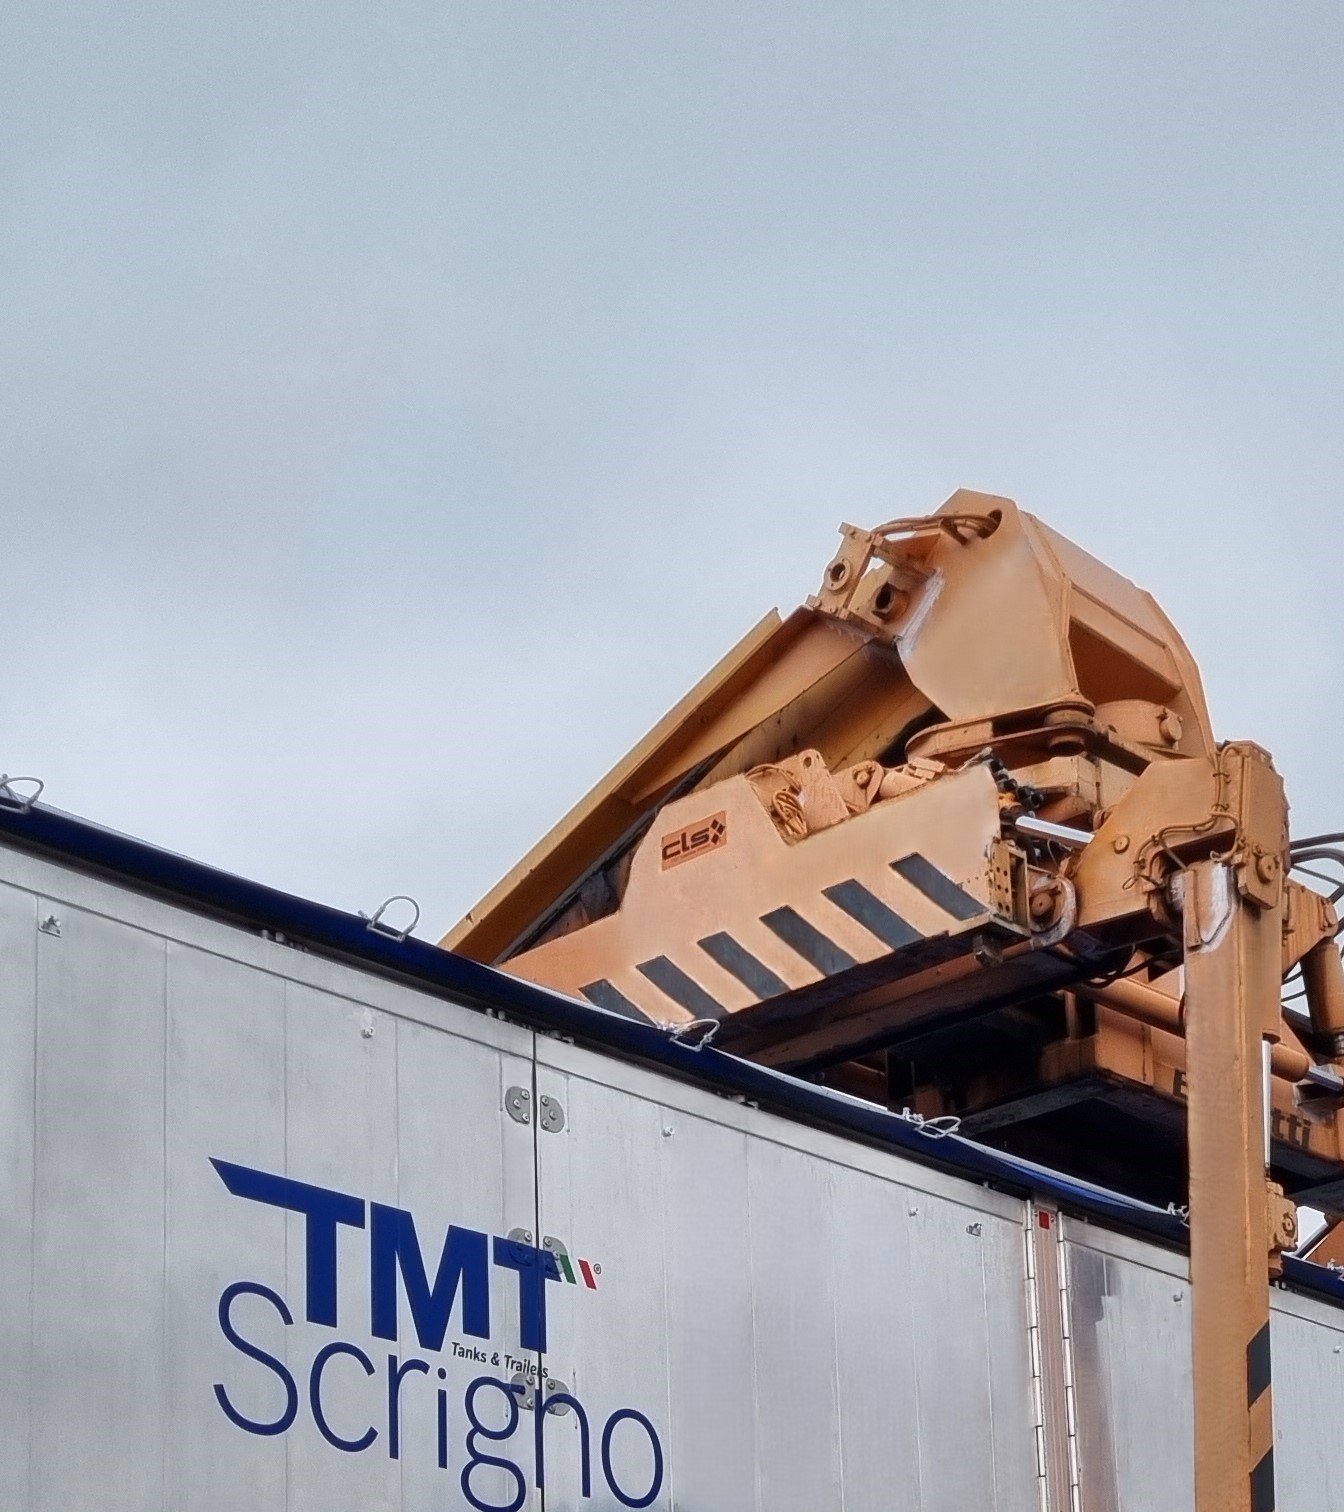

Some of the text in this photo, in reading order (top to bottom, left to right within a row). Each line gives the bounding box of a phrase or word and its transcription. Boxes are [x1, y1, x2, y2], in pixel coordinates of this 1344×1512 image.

[209, 1157, 563, 1354] TMT
[452, 1341, 487, 1363] Tanks
[490, 1351, 501, 1366] &
